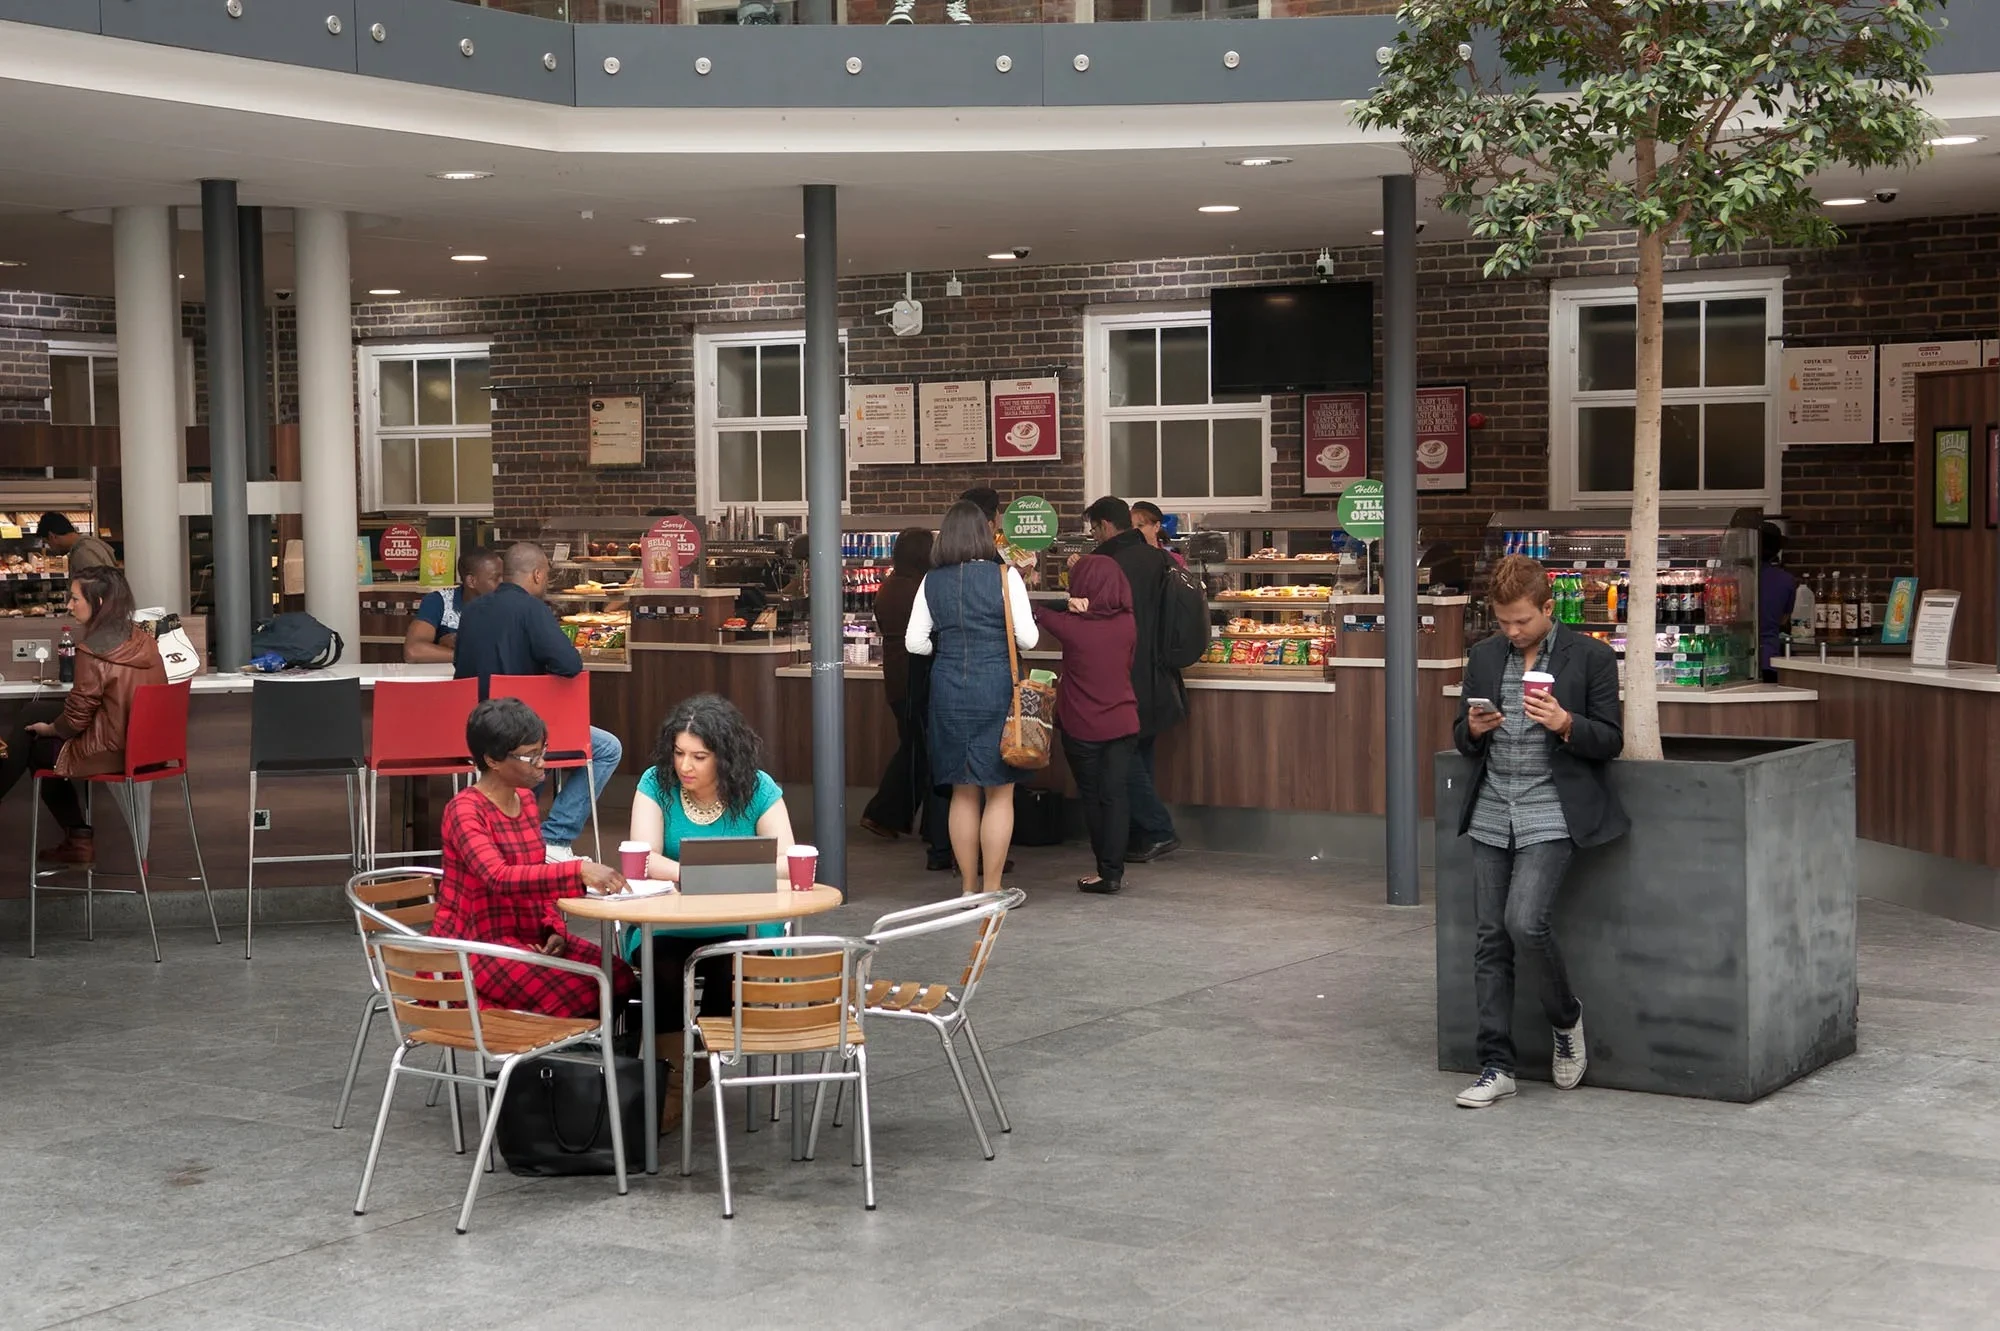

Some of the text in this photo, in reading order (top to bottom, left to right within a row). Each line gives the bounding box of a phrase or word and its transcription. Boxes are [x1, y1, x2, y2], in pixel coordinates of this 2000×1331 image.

[1940, 433, 1966, 453] HELLO
[1353, 484, 1384, 494] Hello!
[1017, 500, 1044, 509] Hello!
[1354, 500, 1383, 510] TILL
[1017, 515, 1044, 524] TILL
[1351, 510, 1384, 520] OPEN
[661, 520, 687, 529] Sorry!
[391, 527, 412, 536] Sorry!
[1014, 525, 1047, 534] OPEN
[391, 539, 412, 548] TILL
[427, 539, 451, 549] HELLO
[647, 538, 672, 548] HELLO
[384, 548, 418, 557] CLOSED
